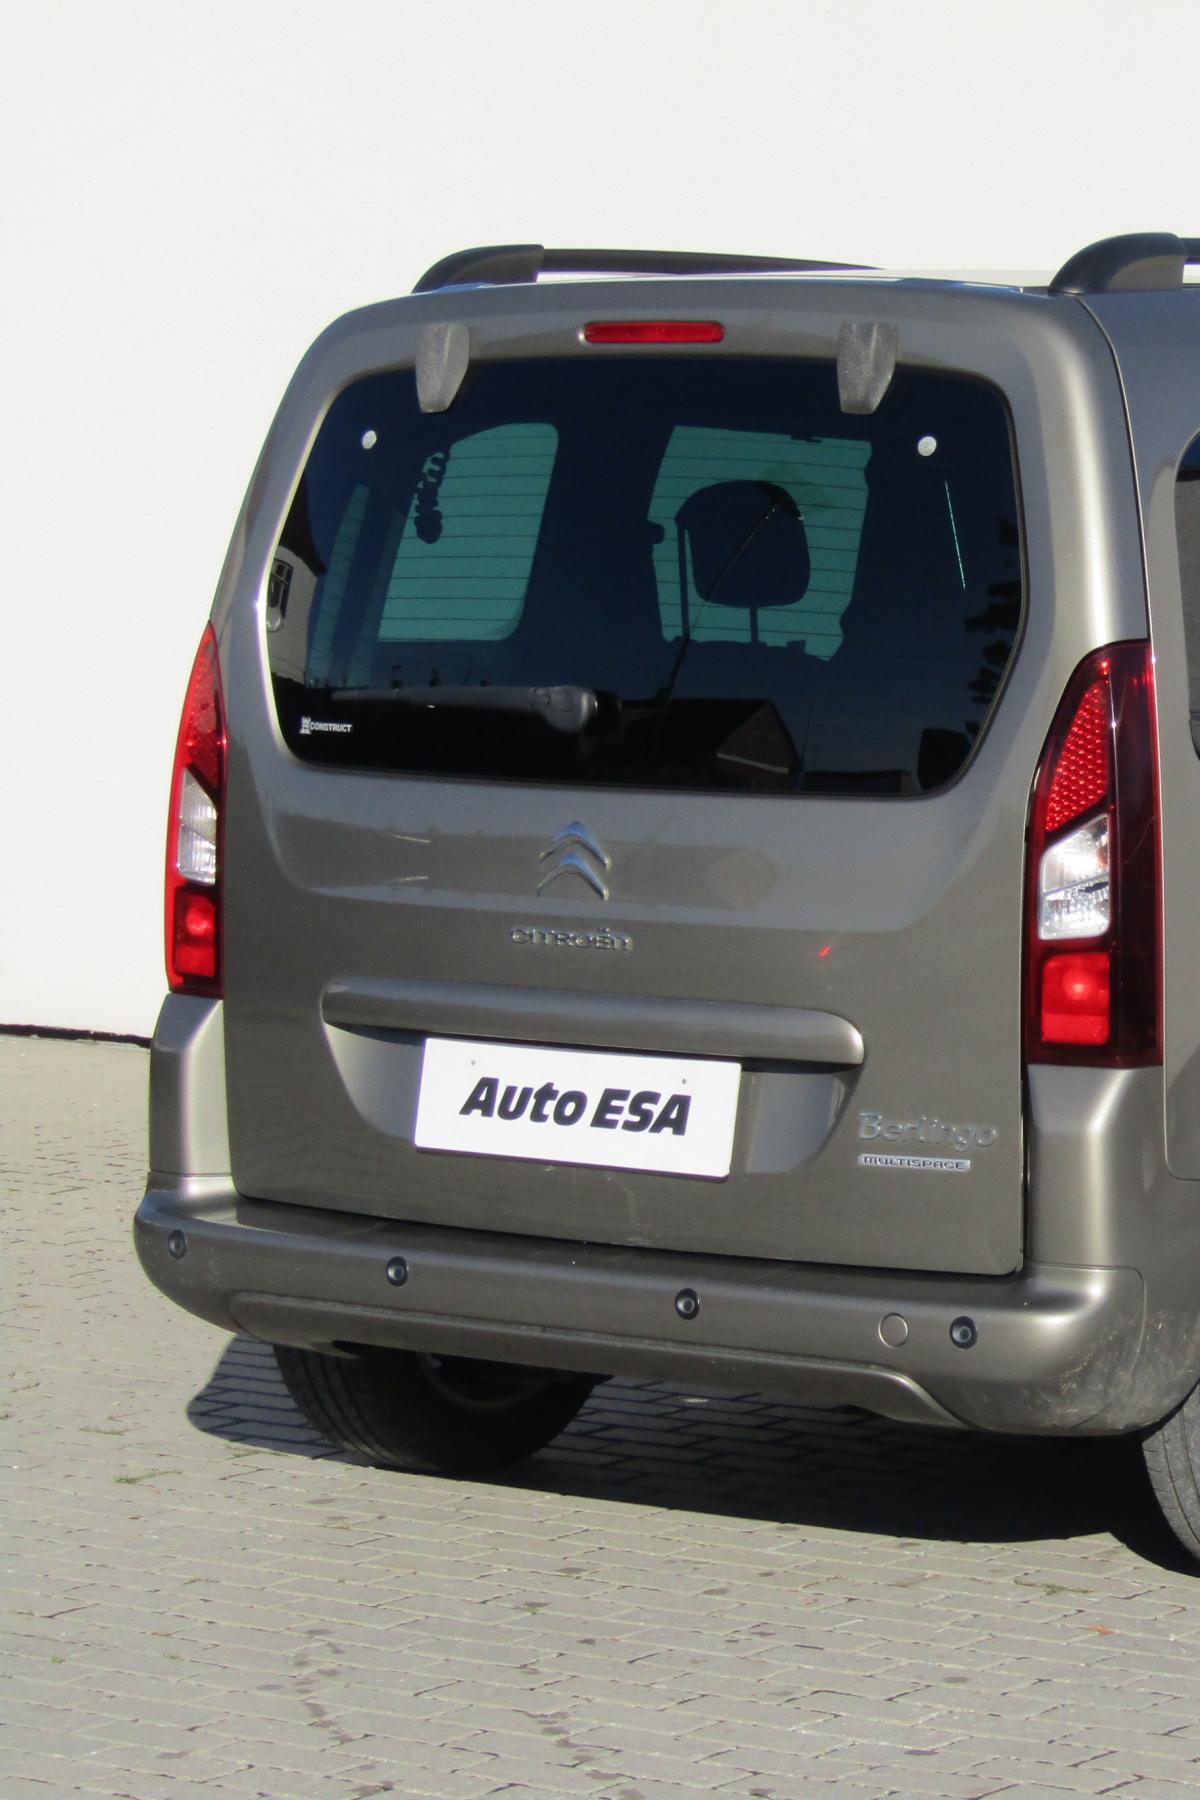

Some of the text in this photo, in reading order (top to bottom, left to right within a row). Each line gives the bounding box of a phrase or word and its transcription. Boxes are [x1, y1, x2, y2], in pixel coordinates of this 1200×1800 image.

[459, 1077, 692, 1136] Auto ESA
[857, 1112, 998, 1150] Berlingo
[863, 1156, 966, 1170] MULTISPACE
